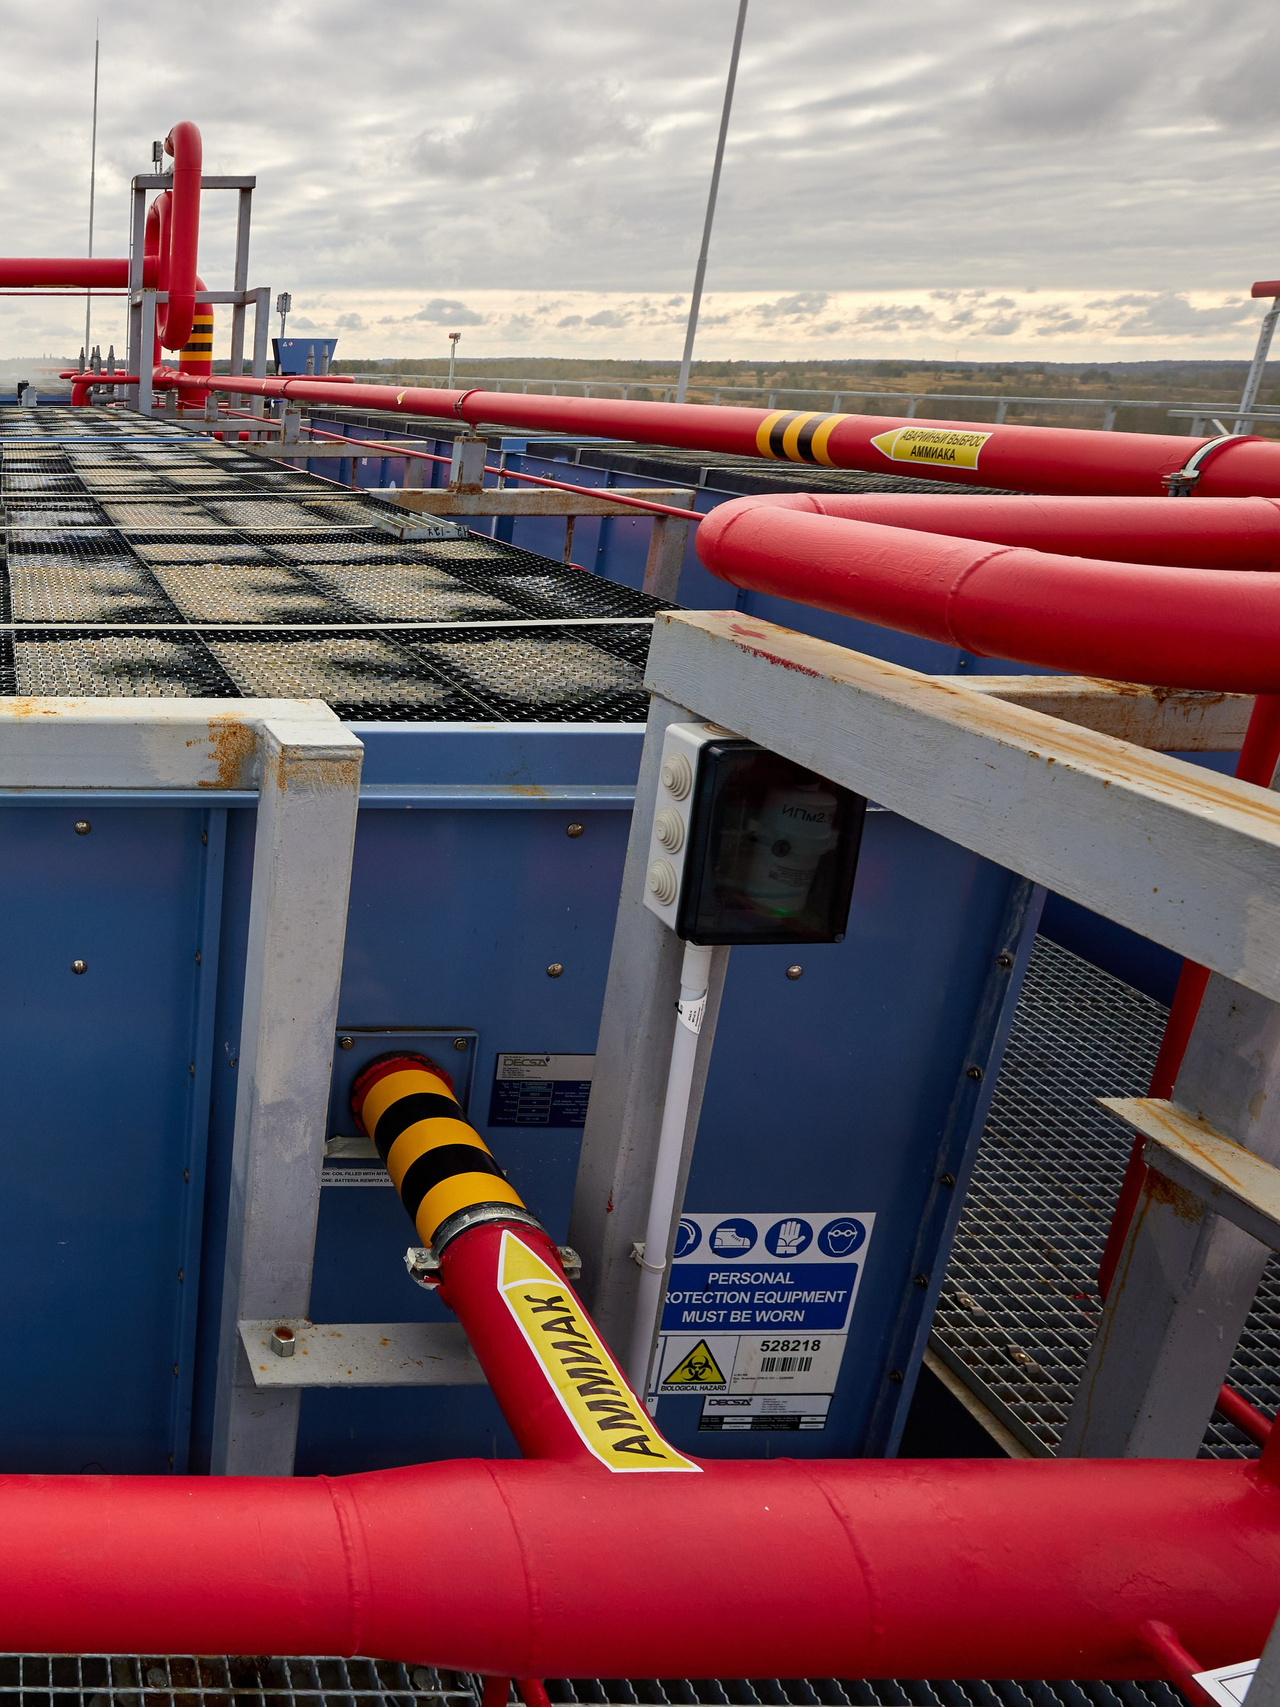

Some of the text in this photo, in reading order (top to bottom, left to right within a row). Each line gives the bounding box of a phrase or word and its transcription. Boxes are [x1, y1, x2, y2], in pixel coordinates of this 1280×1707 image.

[900, 430, 986, 447] АВАРИЙНЫЙ ВЫБРОС
[910, 445, 956, 461] АММИАКА
[503, 1058, 548, 1067] DECSA
[708, 1272, 795, 1285] PERSONAL
[664, 1290, 847, 1304] ROTECTION EQUIPMENT
[681, 1309, 805, 1323] MUST BE WORN
[759, 1339, 821, 1352] 528218
[523, 1294, 668, 1460] АММИАК
[708, 1399, 752, 1407] DECSA
